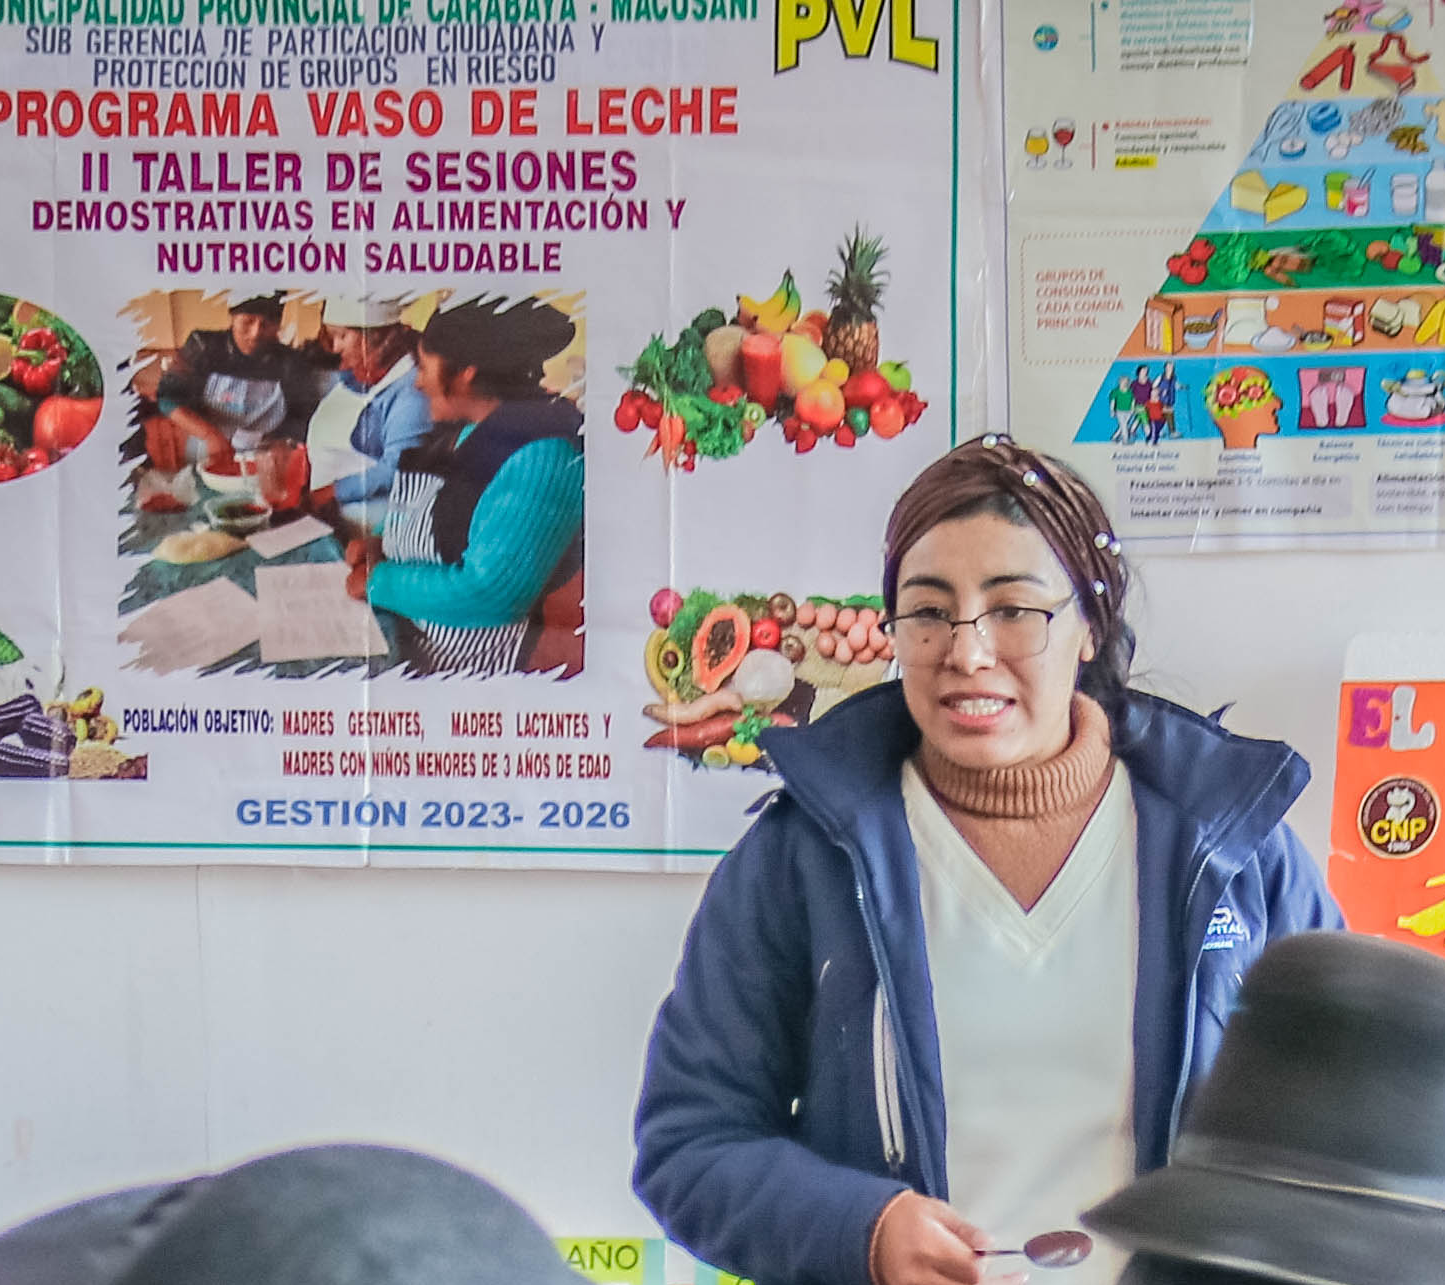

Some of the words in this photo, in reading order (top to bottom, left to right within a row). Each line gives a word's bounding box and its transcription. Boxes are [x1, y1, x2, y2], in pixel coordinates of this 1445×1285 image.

[198, 0, 371, 24] PROVINCIAL
[380, 0, 412, 23] DE
[428, 0, 578, 22] CARABAYA
[610, 0, 760, 22] MACUSANI
[25, 27, 72, 54] SUB
[86, 28, 207, 56] GERENCIA
[223, 29, 253, 56] DE
[268, 18, 426, 56] PARTICACIÓN
[436, 22, 576, 54] CIUDADANA
[591, 24, 605, 52] Y
[773, 0, 939, 75] PVL
[93, 50, 248, 88] PROTECCIÓN
[260, 61, 291, 89] DE
[300, 57, 398, 87] GRUPOS
[427, 56, 456, 84] EN
[466, 54, 556, 85] RIESGO
[309, 90, 444, 137] VASO
[471, 90, 539, 137] DE
[566, 87, 740, 136] LECHE
[81, 152, 109, 193] II
[133, 151, 303, 193] TALLER
[327, 152, 382, 193] DE
[405, 150, 638, 193] SESIONES
[32, 200, 315, 232] DEMOSTRATIVAS
[331, 200, 375, 232] EN
[392, 193, 649, 231] ALIMENTACIÓN
[667, 200, 687, 230] Y
[156, 235, 348, 273] NUTRICIÓN
[363, 243, 563, 273] SALUDABLE
[1036, 269, 1087, 282] GRUPOS
[1088, 268, 1106, 281] DE
[1036, 285, 1101, 297] CONSUMO
[1102, 284, 1120, 296] EN
[1036, 301, 1070, 313] CADA
[1073, 299, 1124, 312] COMIDA
[1036, 316, 1099, 329] PRINCIPAL
[123, 703, 199, 734] POBLACIÓN
[203, 708, 275, 735] OBJETIVO:
[282, 711, 334, 737] MADRES
[348, 711, 425, 742] GESTANTES,
[451, 711, 503, 738] MADRES
[516, 711, 590, 738] LACTANTES
[603, 712, 612, 738] Y
[1346, 685, 1436, 751] EL
[282, 751, 334, 777] MADRES
[339, 751, 367, 777] CON
[372, 748, 410, 777] NIÑOS
[416, 751, 477, 777] MENORES
[482, 752, 498, 777] DE
[502, 752, 511, 777] 3
[516, 747, 551, 778] AÑOS
[556, 752, 574, 778] DE
[577, 752, 612, 778] EDAD
[236, 794, 408, 828] GESTIÓN
[421, 801, 525, 828] 2023-
[539, 801, 631, 829] 2026
[1370, 816, 1428, 845] CNP
[565, 1240, 639, 1270] AÑO
